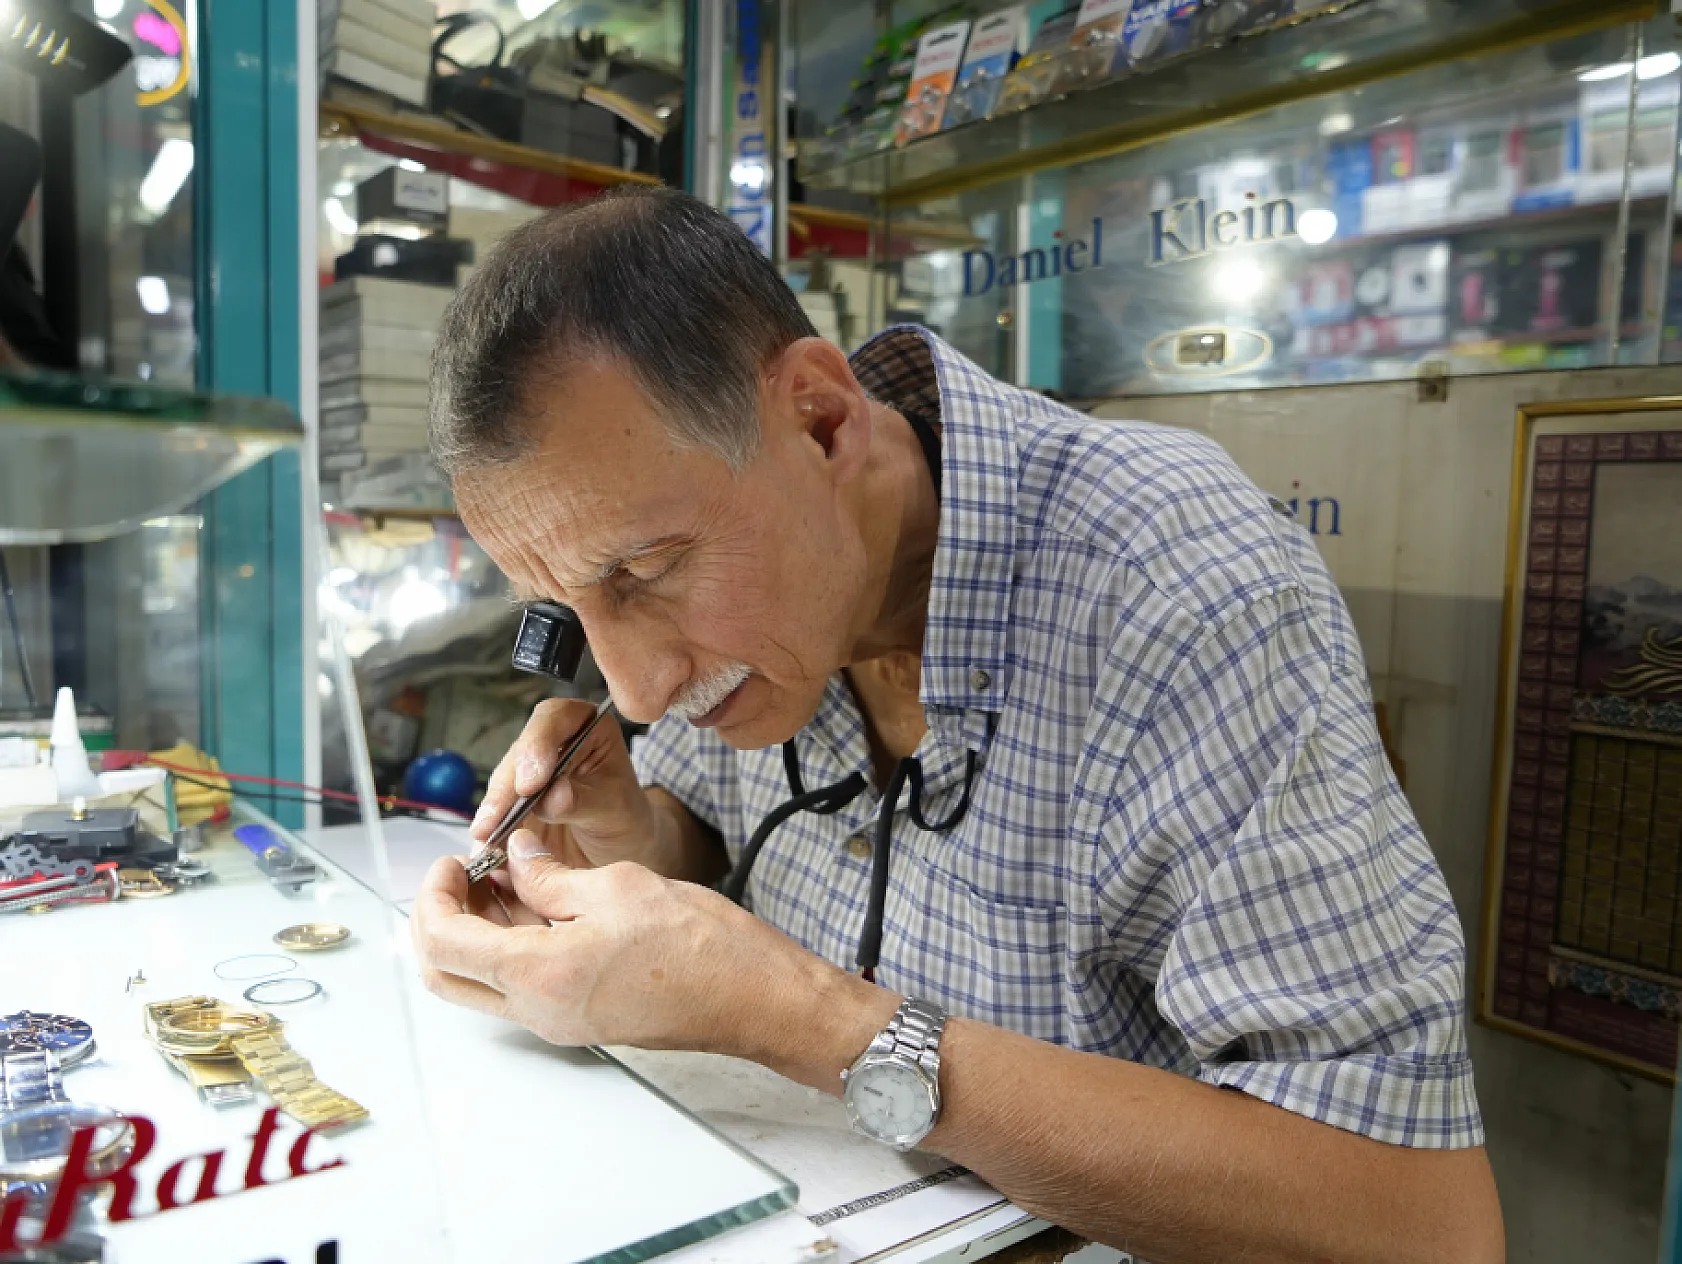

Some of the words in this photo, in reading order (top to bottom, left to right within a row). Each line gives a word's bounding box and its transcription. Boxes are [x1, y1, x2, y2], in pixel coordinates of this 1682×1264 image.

[962, 216, 1102, 297] Daniel
[1150, 191, 1298, 263] Klein
[1287, 480, 1343, 535] in
